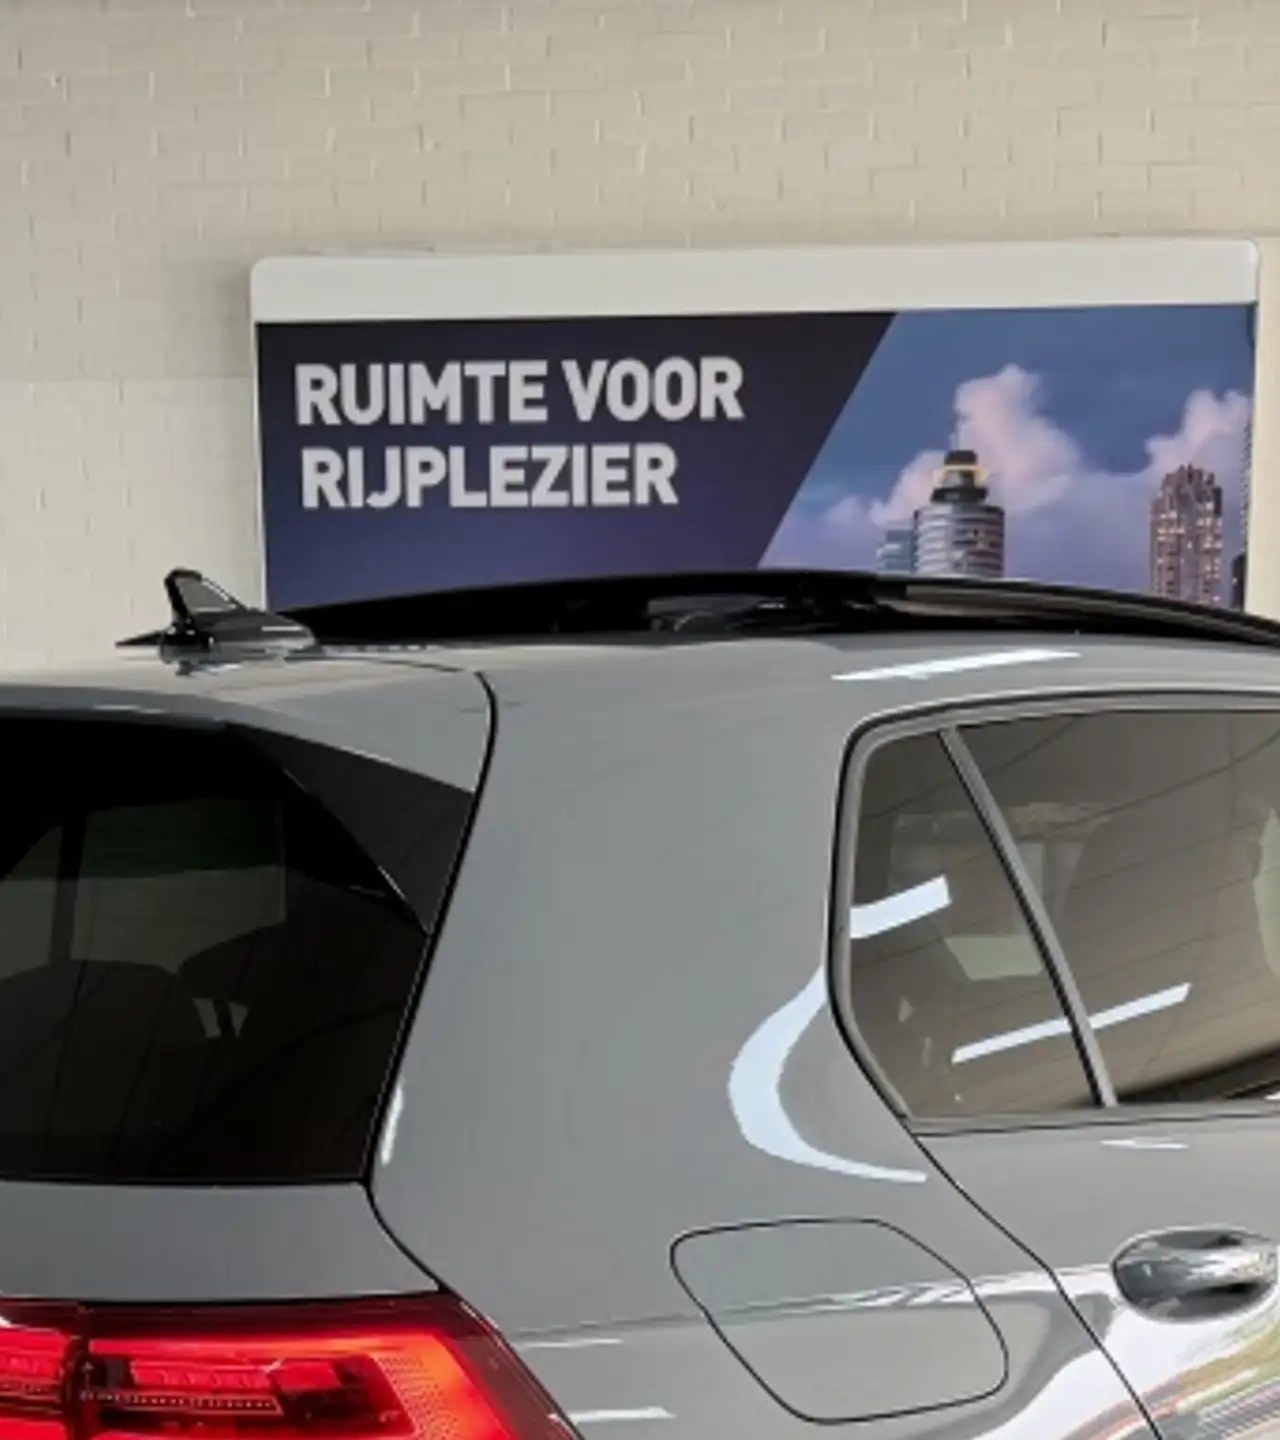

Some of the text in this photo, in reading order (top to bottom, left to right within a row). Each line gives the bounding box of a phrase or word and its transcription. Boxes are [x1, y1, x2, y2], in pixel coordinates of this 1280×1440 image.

[295, 357, 745, 426] RUIMTE VOOR
[301, 442, 680, 509] RIJPLEZIER
